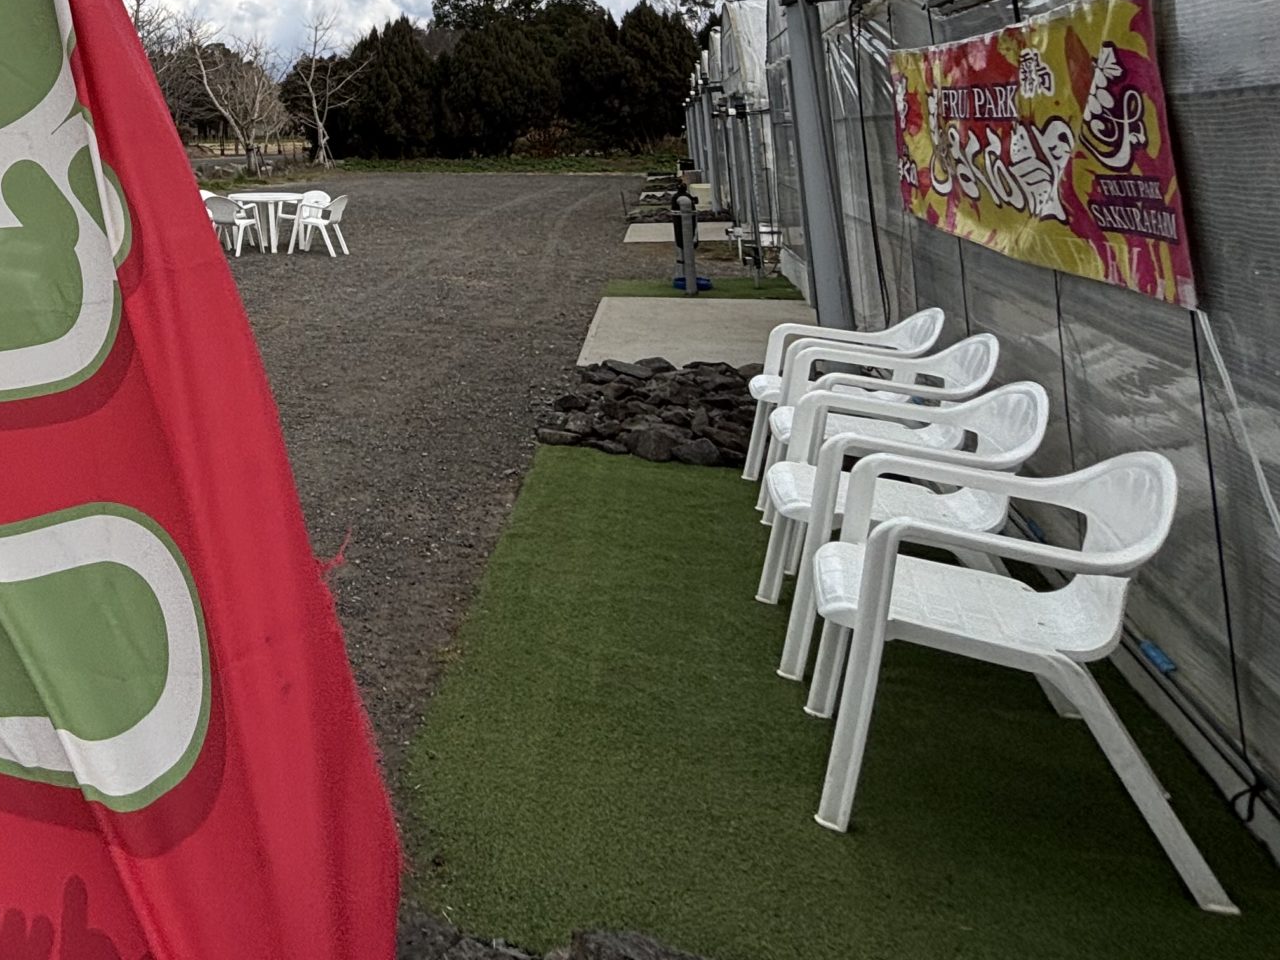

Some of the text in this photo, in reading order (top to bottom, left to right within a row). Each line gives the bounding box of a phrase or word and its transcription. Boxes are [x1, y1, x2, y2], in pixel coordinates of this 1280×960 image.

[972, 85, 1018, 118] PARK
[1100, 179, 1163, 200] FRUIT PARK
